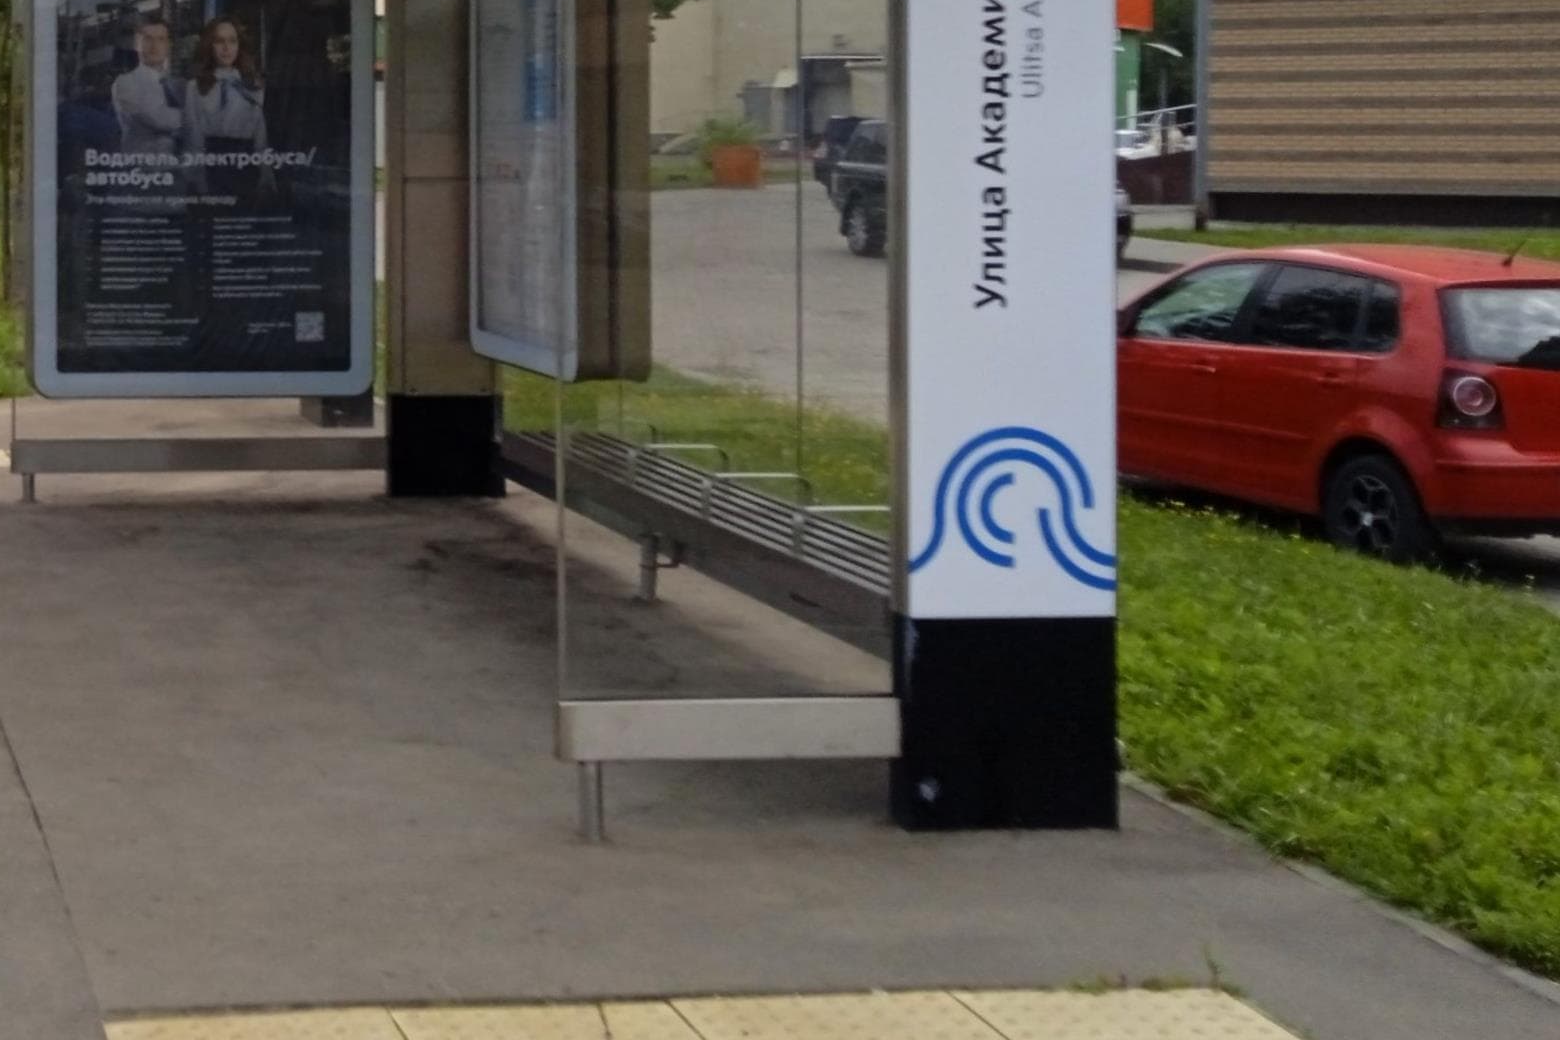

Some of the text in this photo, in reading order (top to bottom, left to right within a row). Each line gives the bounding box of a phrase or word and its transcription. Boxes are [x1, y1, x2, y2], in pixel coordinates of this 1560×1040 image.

[1021, 27, 1044, 98] Ulitsa
[85, 148, 179, 168] Водитель
[85, 168, 174, 189] автобуса
[973, 186, 1011, 307] Улица
